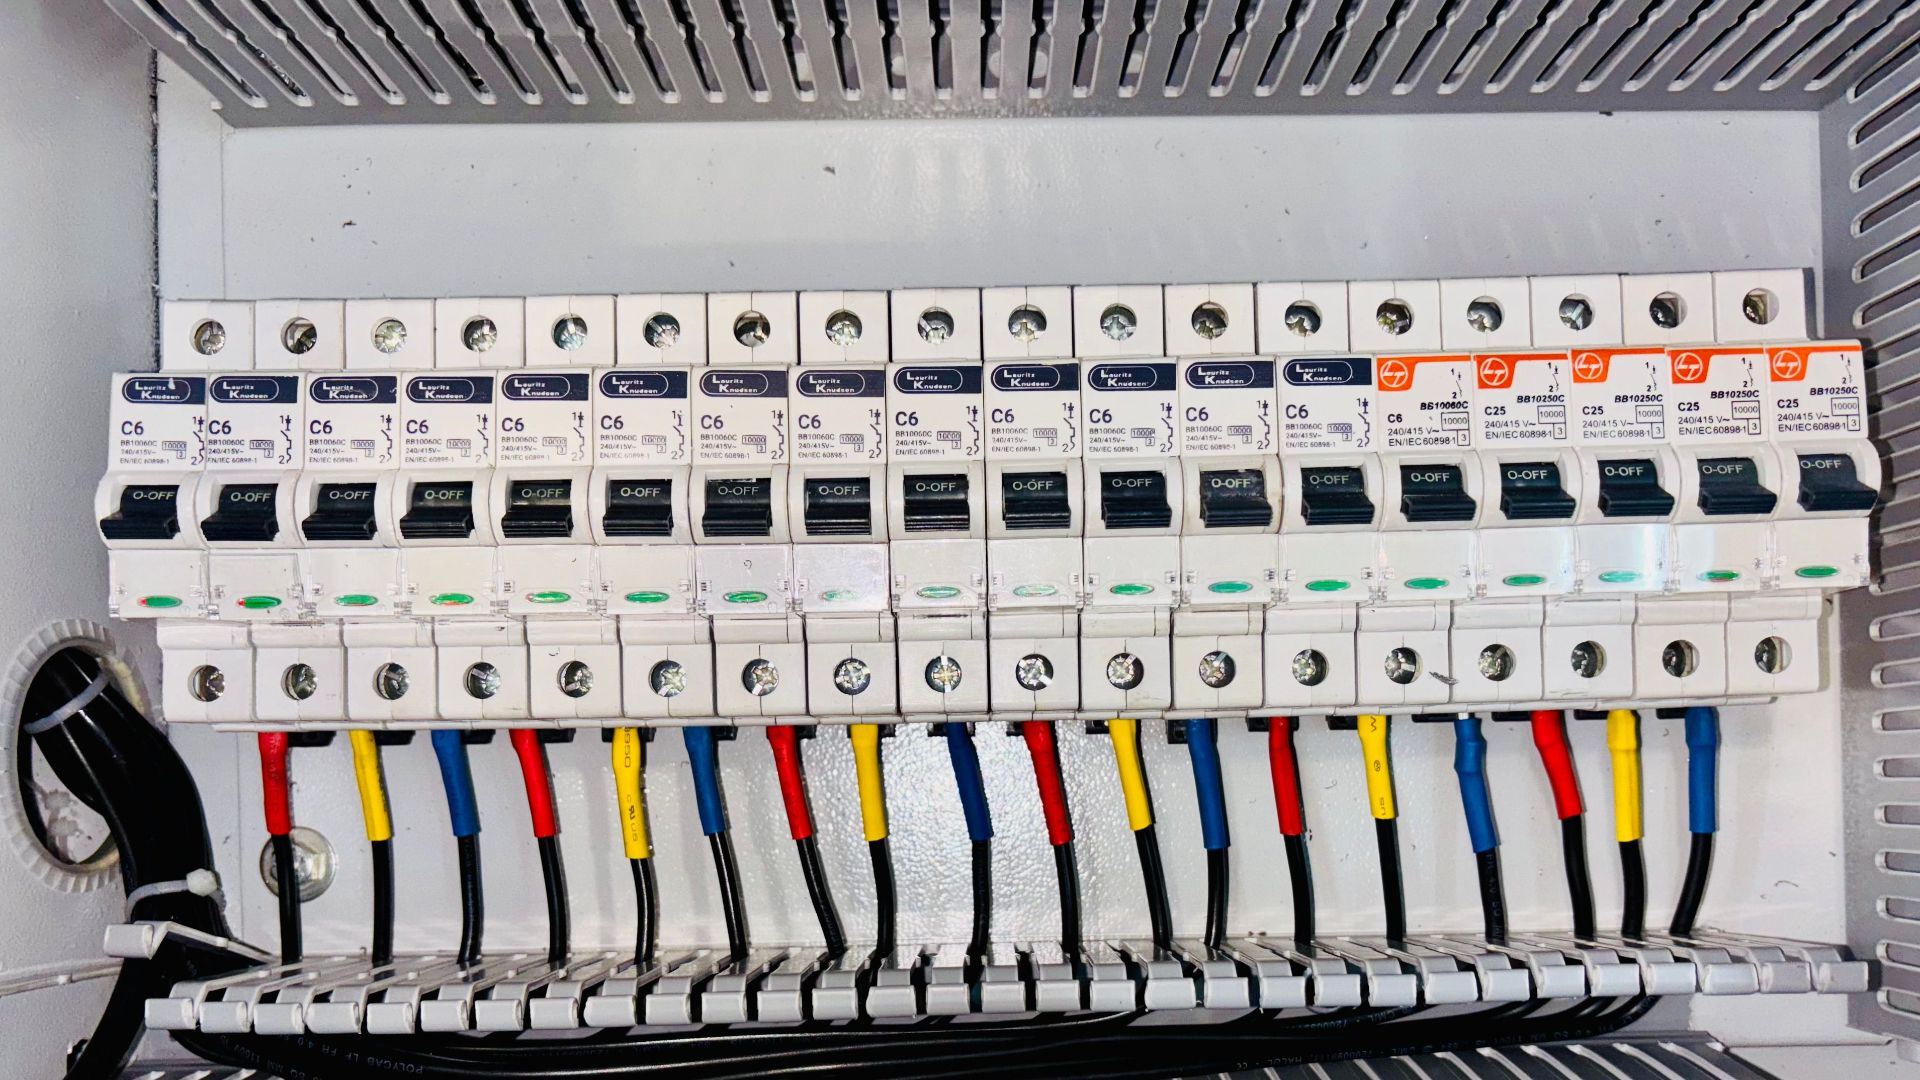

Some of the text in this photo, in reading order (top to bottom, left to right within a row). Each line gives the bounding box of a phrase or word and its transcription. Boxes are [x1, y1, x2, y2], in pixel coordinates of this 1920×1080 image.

[1711, 390, 1759, 399] BB10250C
[1810, 387, 1858, 395] BB10250C
[1517, 395, 1565, 403] BB10250C
[1615, 394, 1663, 402] BB10250C
[1777, 399, 1799, 408] C25
[1286, 405, 1308, 419] C6
[1485, 407, 1506, 415] C25
[1583, 406, 1604, 415] C25
[1678, 402, 1699, 411] C25
[896, 412, 918, 426] C6
[992, 409, 1014, 423] C6
[1090, 409, 1112, 423] C6
[1186, 407, 1208, 421] C6
[1388, 414, 1402, 422] C6
[1778, 413, 1813, 421] 240/415
[502, 418, 524, 432] C6
[601, 416, 623, 429] C6
[701, 415, 723, 429] C6
[798, 415, 821, 429] C6
[1485, 420, 1519, 428] 240/415
[1678, 416, 1713, 424] 240/415
[121, 421, 144, 435] C6
[209, 420, 231, 434] C6
[310, 420, 332, 434] C6
[406, 420, 429, 433] C6
[1679, 426, 1746, 435] EN/IEC 60898-1
[1618, 430, 1650, 438] 60898-1
[367, 1056, 425, 1074] POLYCAB
